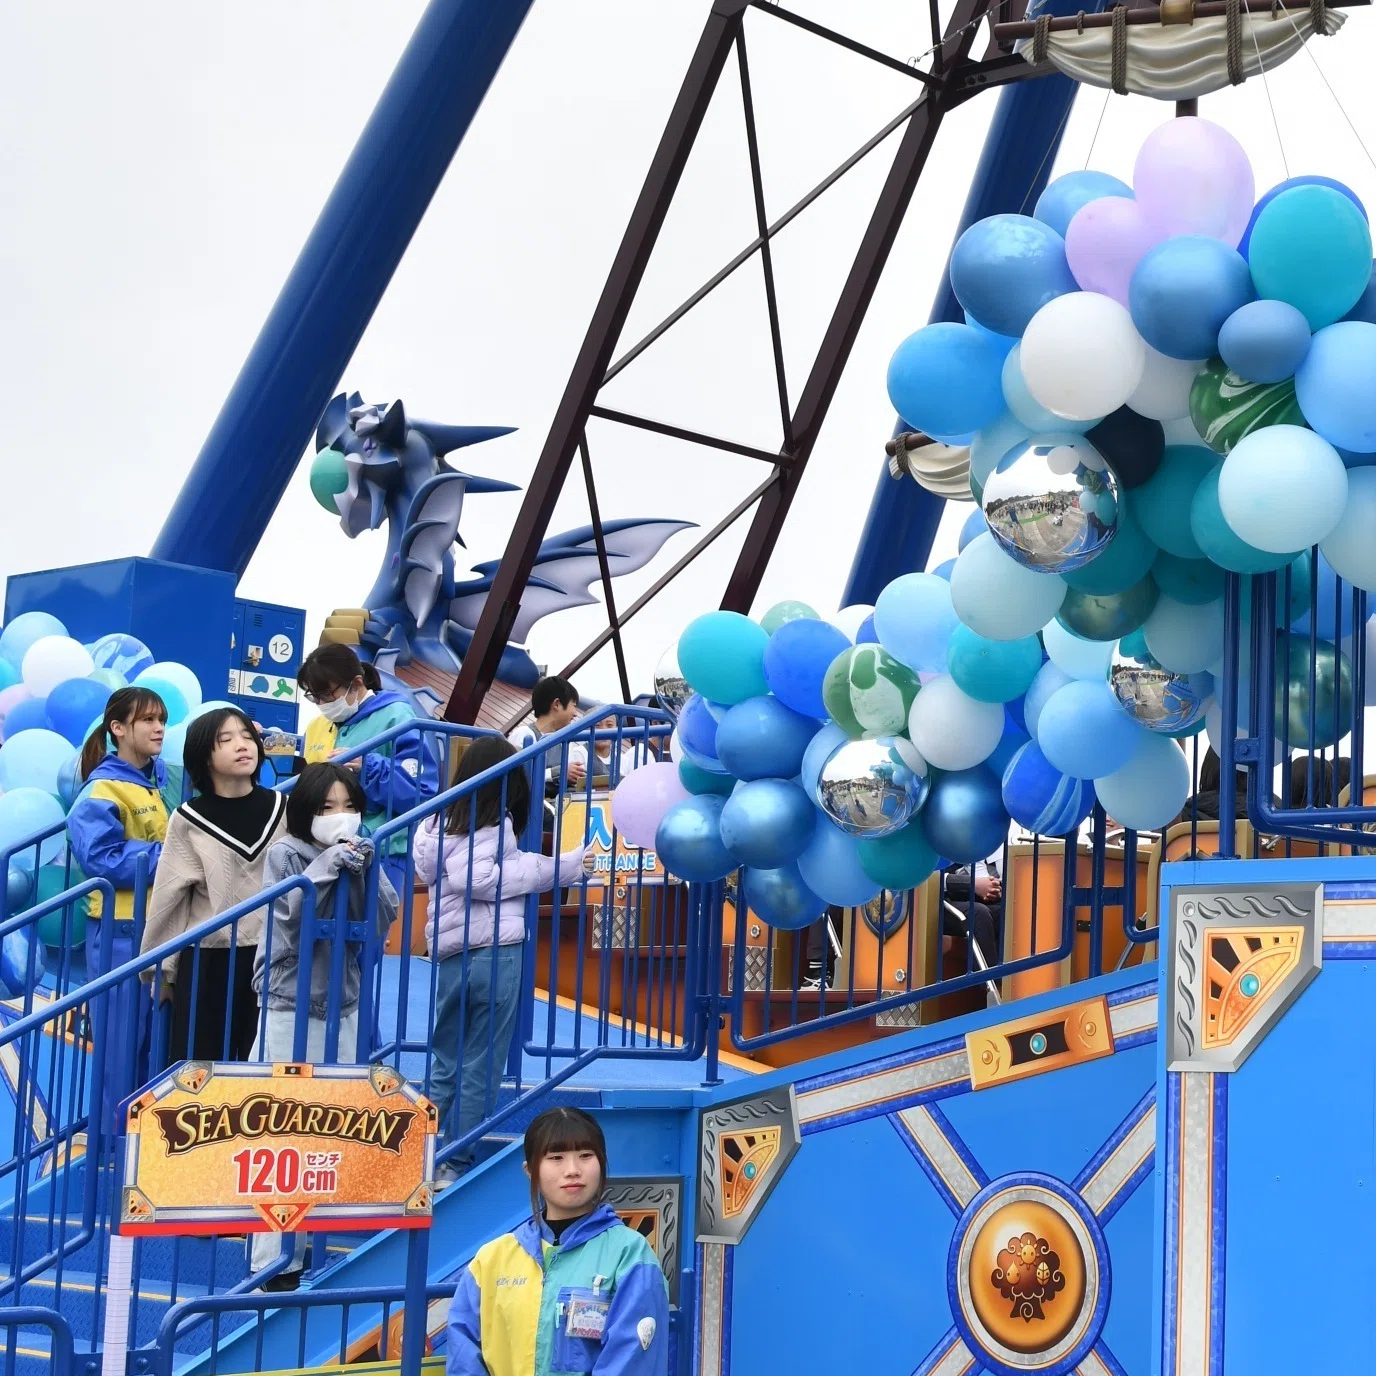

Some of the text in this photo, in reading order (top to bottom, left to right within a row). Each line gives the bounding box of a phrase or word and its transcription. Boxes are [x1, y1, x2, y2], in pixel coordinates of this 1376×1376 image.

[273, 641, 290, 656] 12
[173, 1097, 402, 1150] SEA GUARDIAN
[233, 1149, 336, 1193] 120 cm
[306, 1153, 340, 1167] センチ
